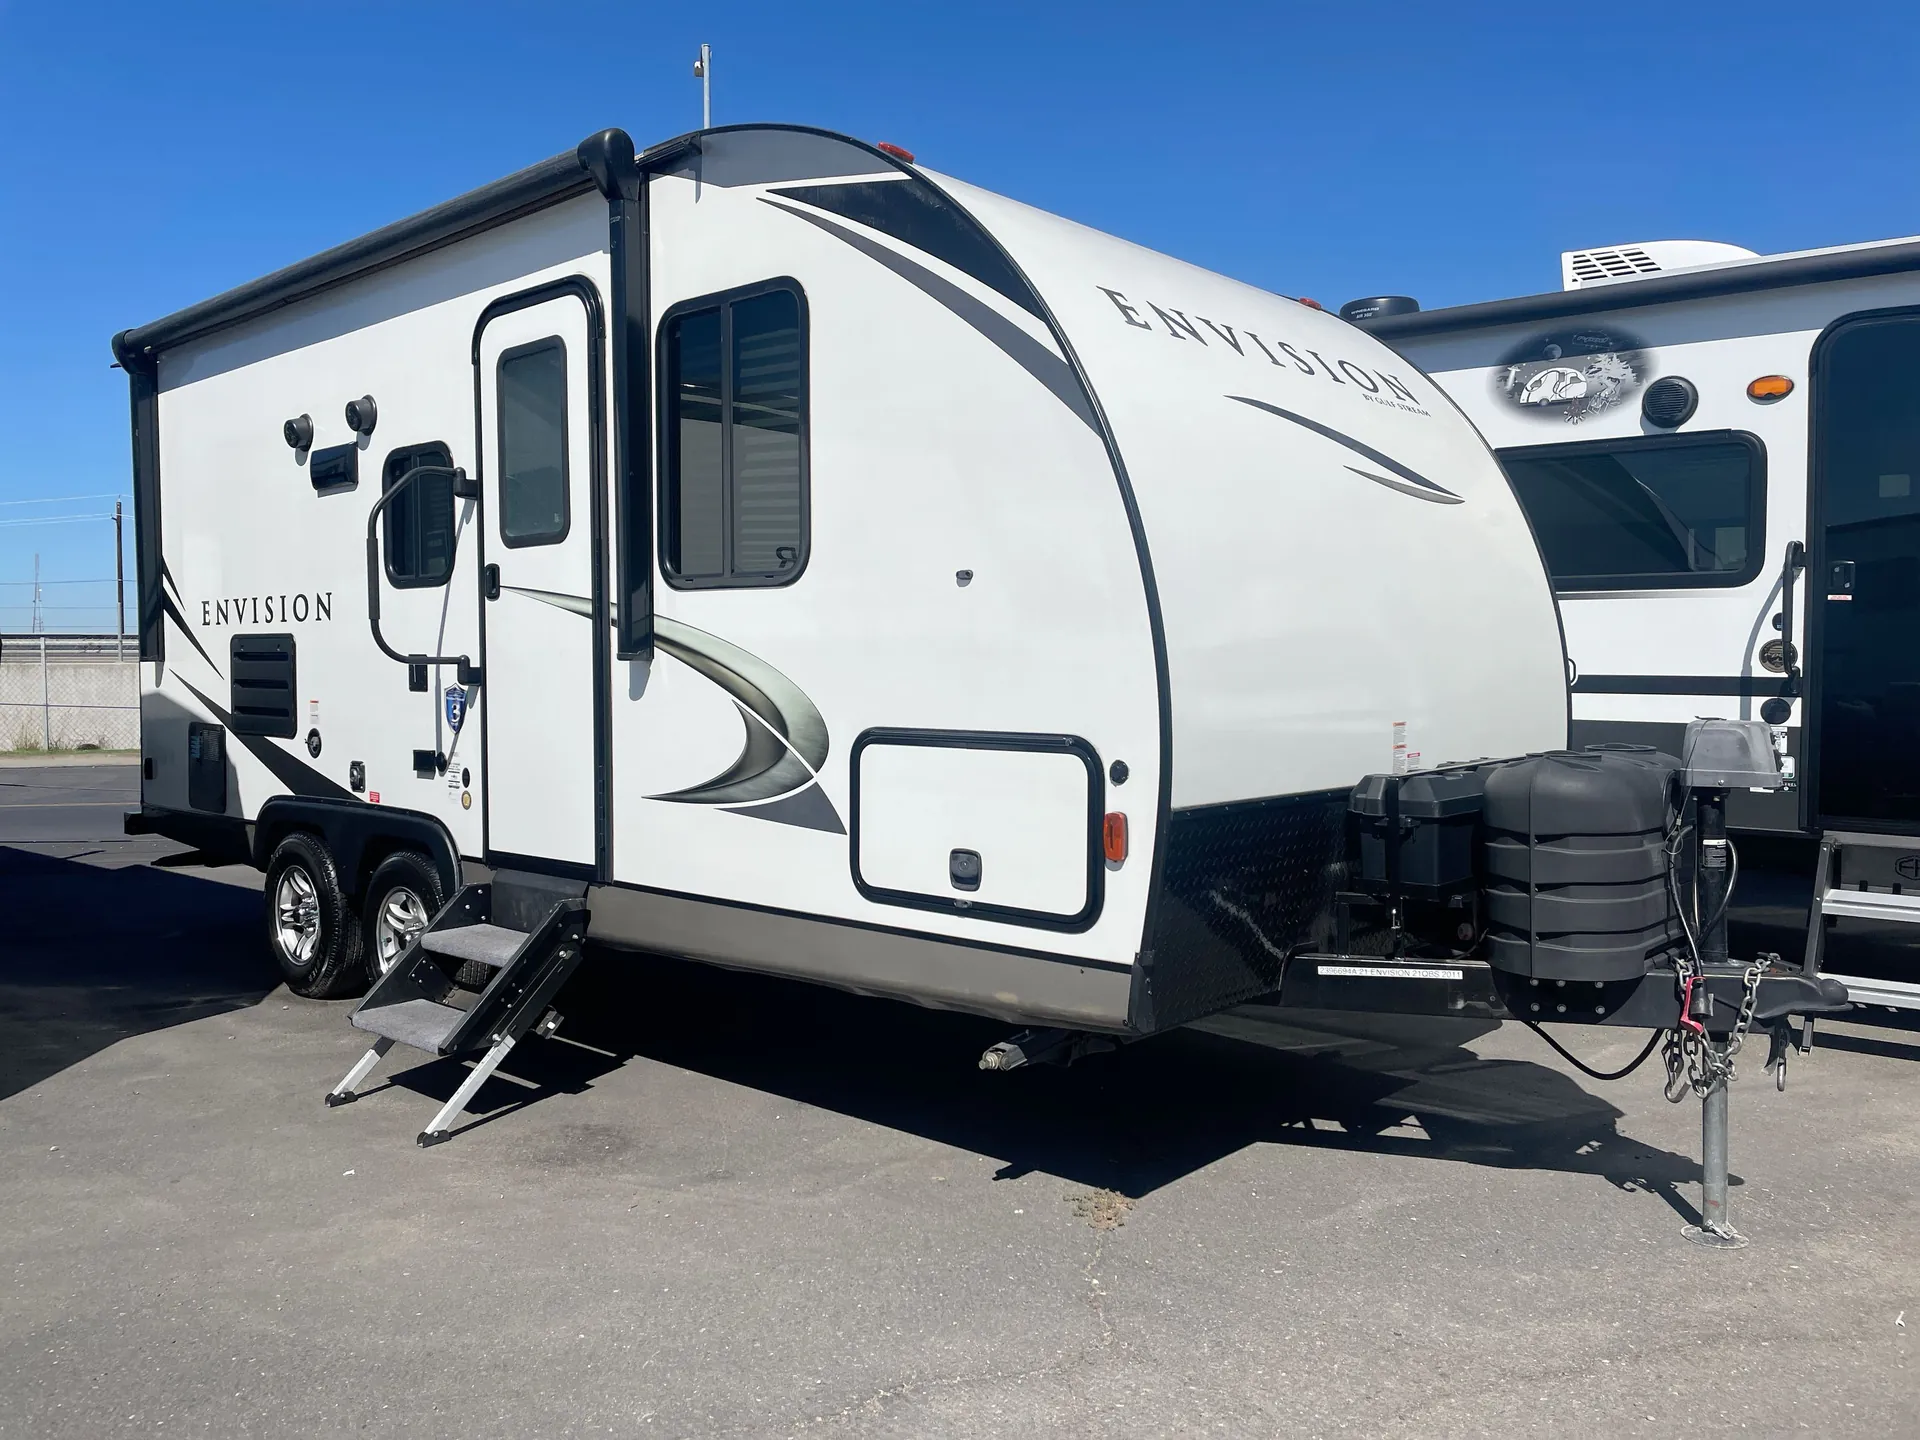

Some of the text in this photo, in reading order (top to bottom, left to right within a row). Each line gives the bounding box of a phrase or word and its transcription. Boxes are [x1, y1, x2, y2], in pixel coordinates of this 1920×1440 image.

[1096, 285, 1421, 406] ENVISION
[1362, 393, 1432, 418] BY GULF STREAM
[201, 592, 333, 626] ENVISION
[451, 703, 461, 722] 3
[1370, 968, 1411, 977] ENVISION
[1412, 969, 1440, 978] 21QBS
